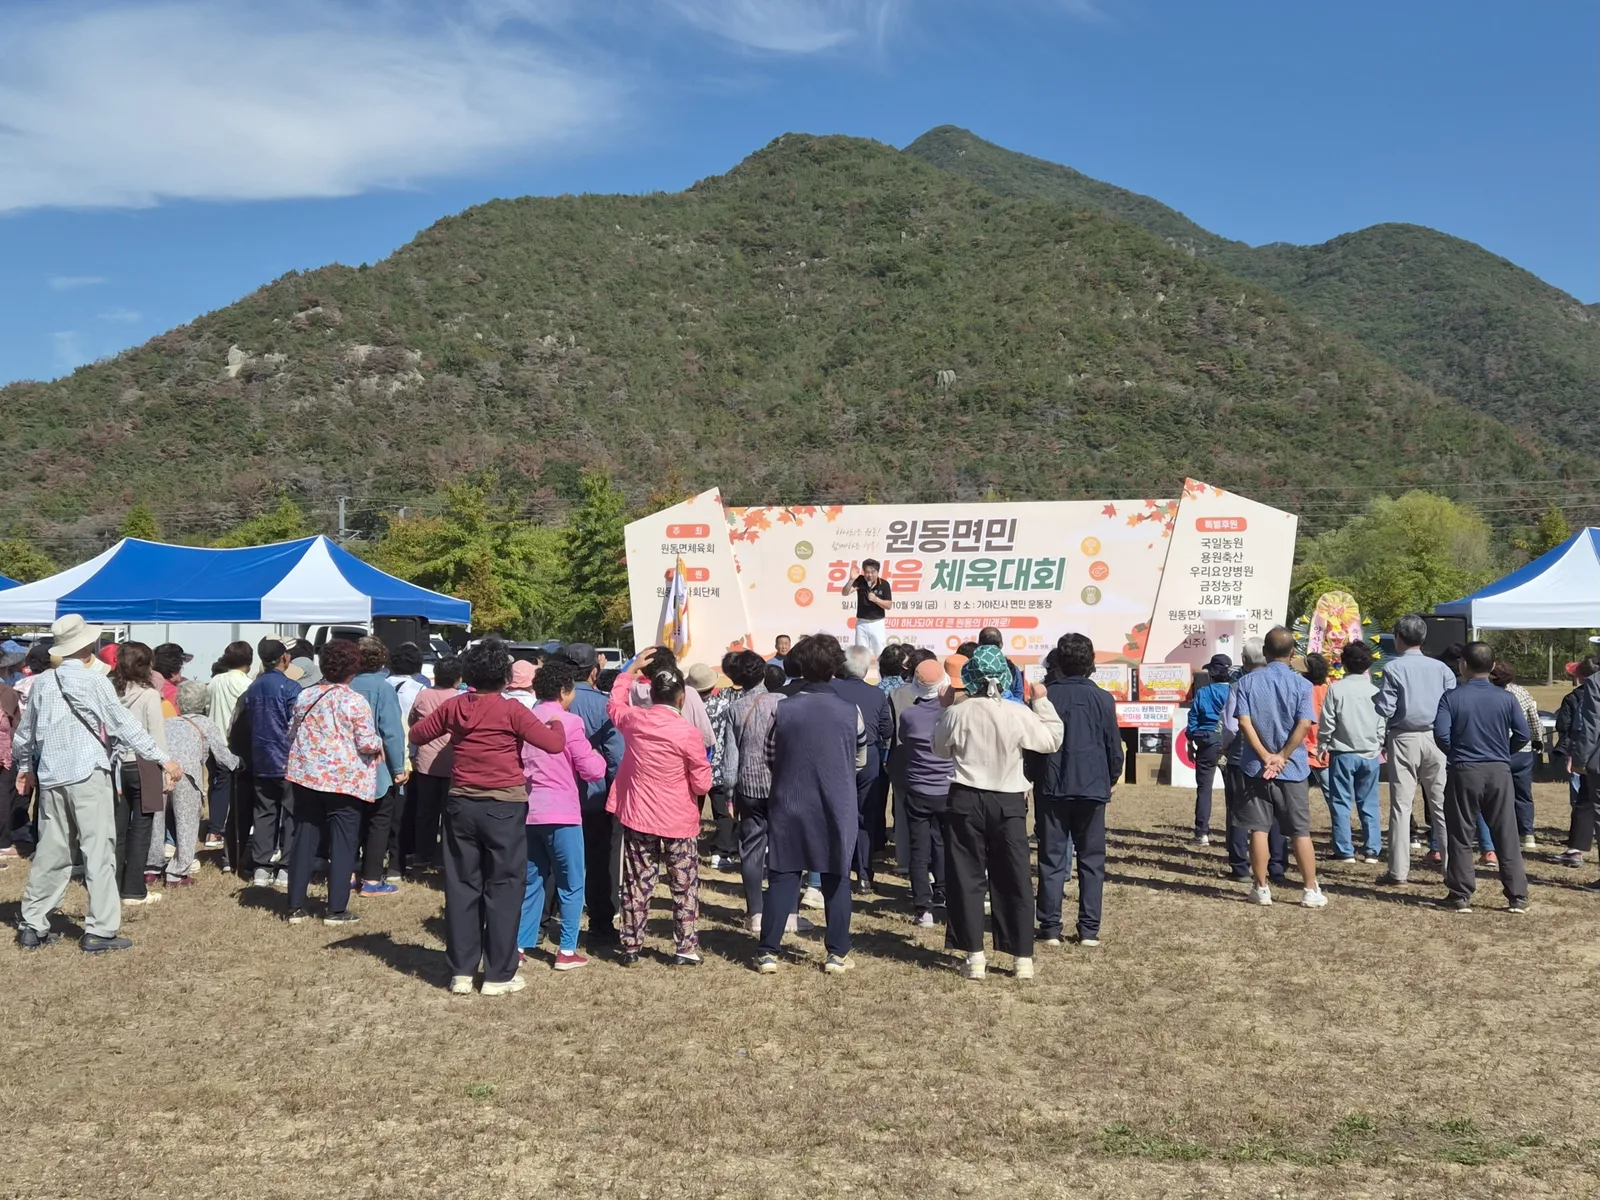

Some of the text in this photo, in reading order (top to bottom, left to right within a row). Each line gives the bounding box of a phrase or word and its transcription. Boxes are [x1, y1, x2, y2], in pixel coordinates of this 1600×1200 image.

[1204, 519, 1239, 530] 특별후원
[885, 519, 1018, 554] 원동면민
[661, 543, 715, 555] 원동면체육회
[1200, 537, 1244, 550] 국일농원
[1200, 551, 1244, 564] 용원축산
[930, 557, 1067, 593] 체육대회
[1189, 565, 1254, 578] 우리요양병원
[1199, 580, 1243, 592] 금정농장
[892, 600, 909, 610] 10월
[910, 600, 923, 610] 9일
[924, 600, 938, 610] (금)
[977, 600, 1009, 610] 가야진사
[1010, 600, 1026, 609] 면민
[1028, 600, 1053, 609] 운동장
[1198, 594, 1243, 606] J&B개발
[901, 618, 933, 628] 하나되어
[935, 618, 944, 628] 더
[945, 618, 954, 628] 큰
[955, 618, 981, 628] 원동의
[982, 617, 1011, 628] 미래로!
